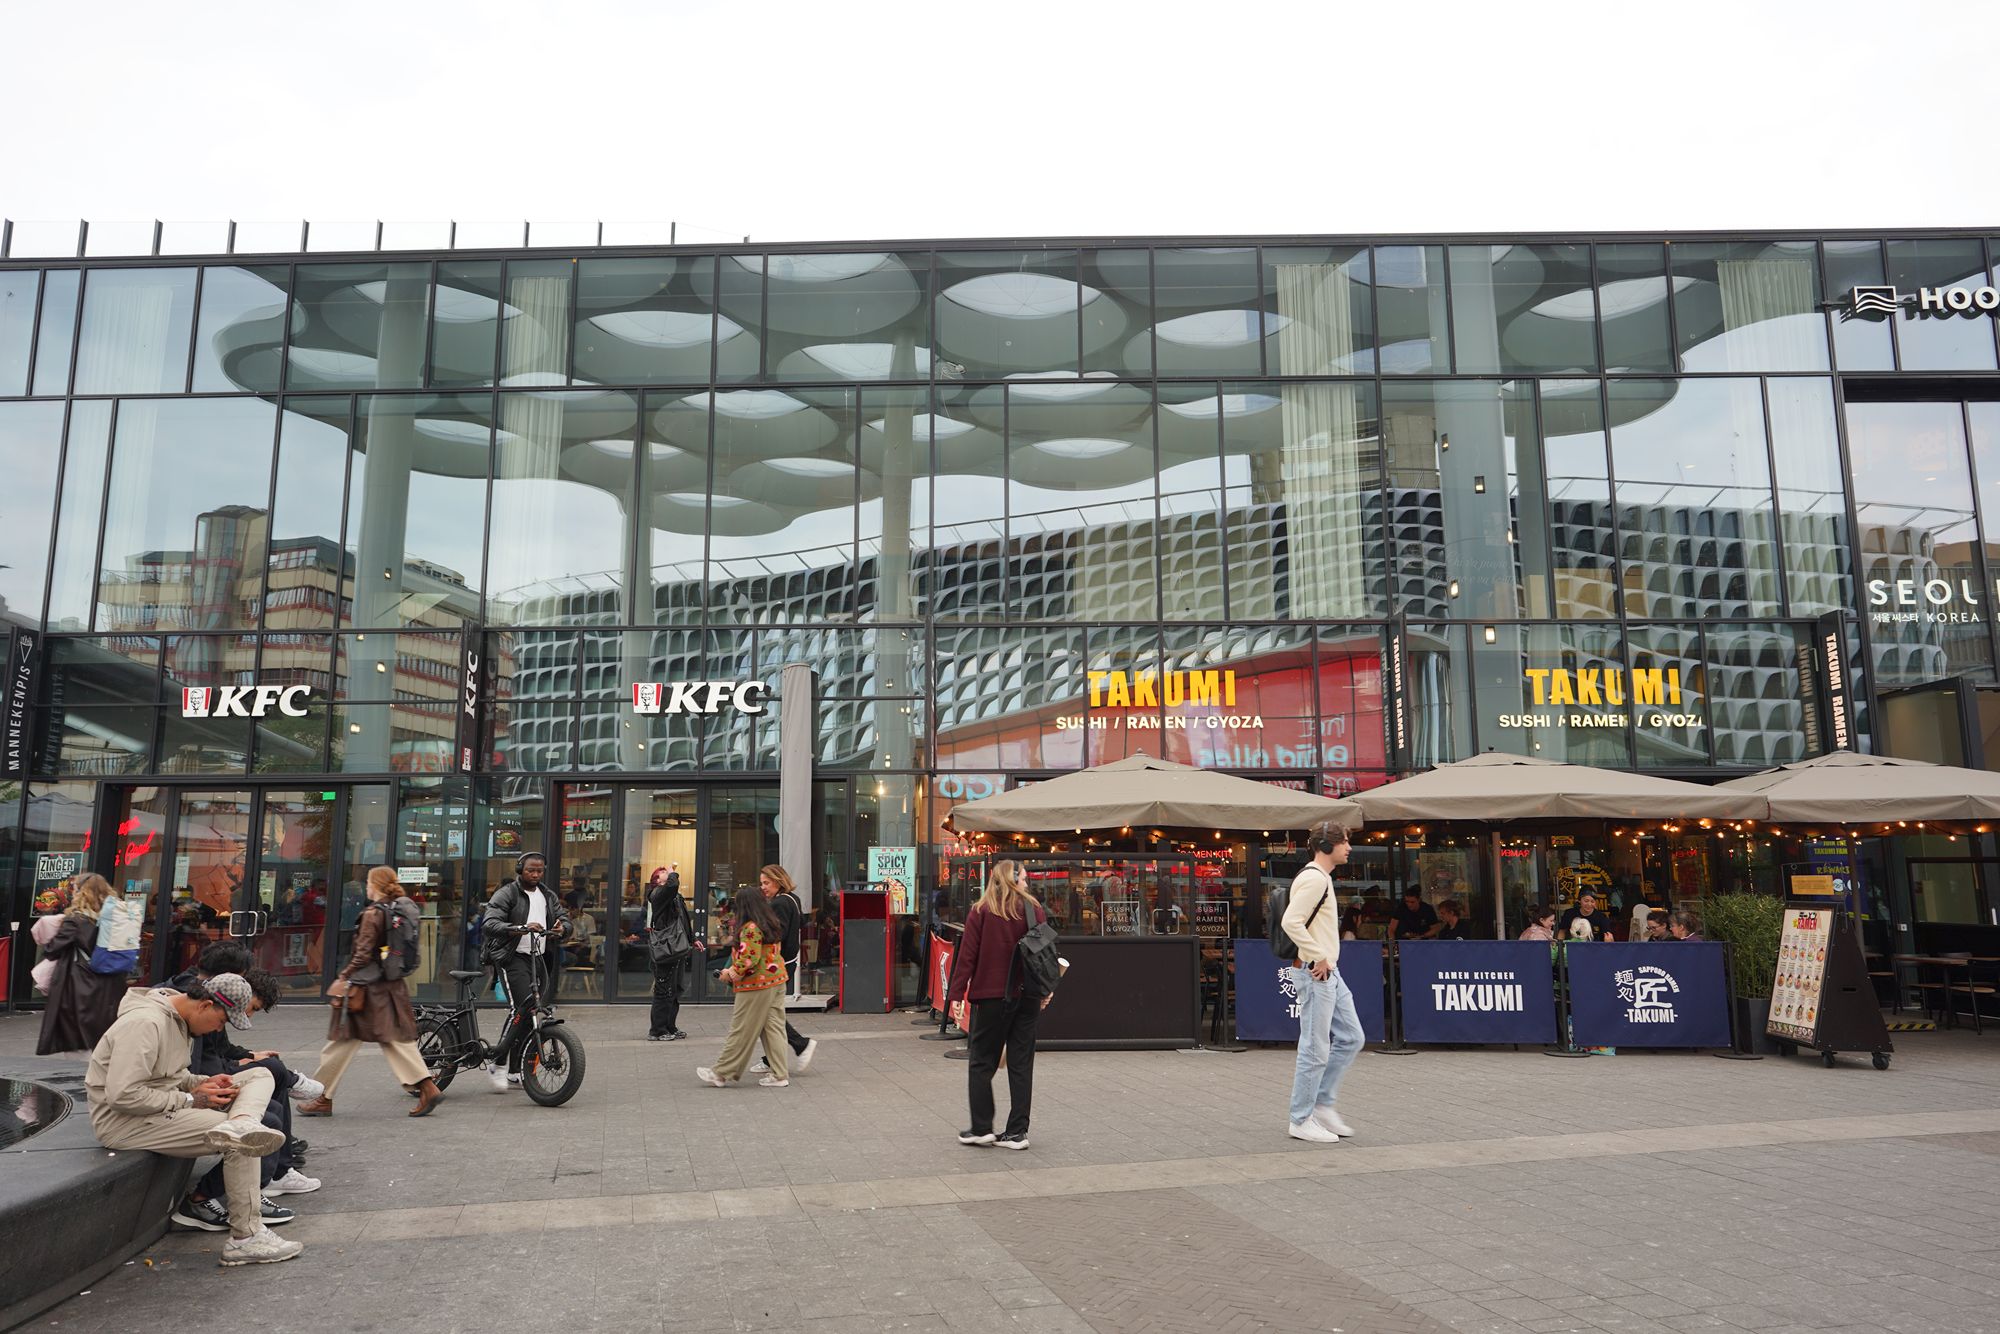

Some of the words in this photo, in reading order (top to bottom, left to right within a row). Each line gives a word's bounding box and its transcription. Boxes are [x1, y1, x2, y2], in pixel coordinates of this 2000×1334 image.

[1926, 612, 1980, 623] KOREA
[1393, 634, 1402, 693] TAKUMI
[1826, 632, 1842, 691] TAKUMI
[464, 650, 479, 719] KFC
[664, 680, 765, 713] KFC
[1087, 670, 1236, 707] TAKUMI
[1525, 668, 1681, 705] TAKUMI
[212, 685, 311, 717] KFC
[8, 665, 31, 771] MANNEKENPIS
[1056, 716, 1107, 730] SUSHI
[1127, 716, 1186, 729] RAMEN
[1206, 715, 1265, 729] GYOZA
[1396, 697, 1405, 750] RAMEN
[1499, 714, 1550, 728] SUSHI
[1832, 695, 1848, 750] RAMEN
[40, 859, 74, 872] ZINGER
[878, 855, 907, 868] SPICY
[943, 844, 998, 857] RAMEN
[1797, 918, 1818, 930] RAMEN
[1438, 971, 1470, 980] RAMEN
[1474, 971, 1515, 980] KITCHEN
[1638, 965, 1667, 977] SAPPORO
[1664, 973, 1681, 993] RAMEN
[1431, 984, 1524, 1011] TAKUMI
[1634, 978, 1673, 1009] 匠
